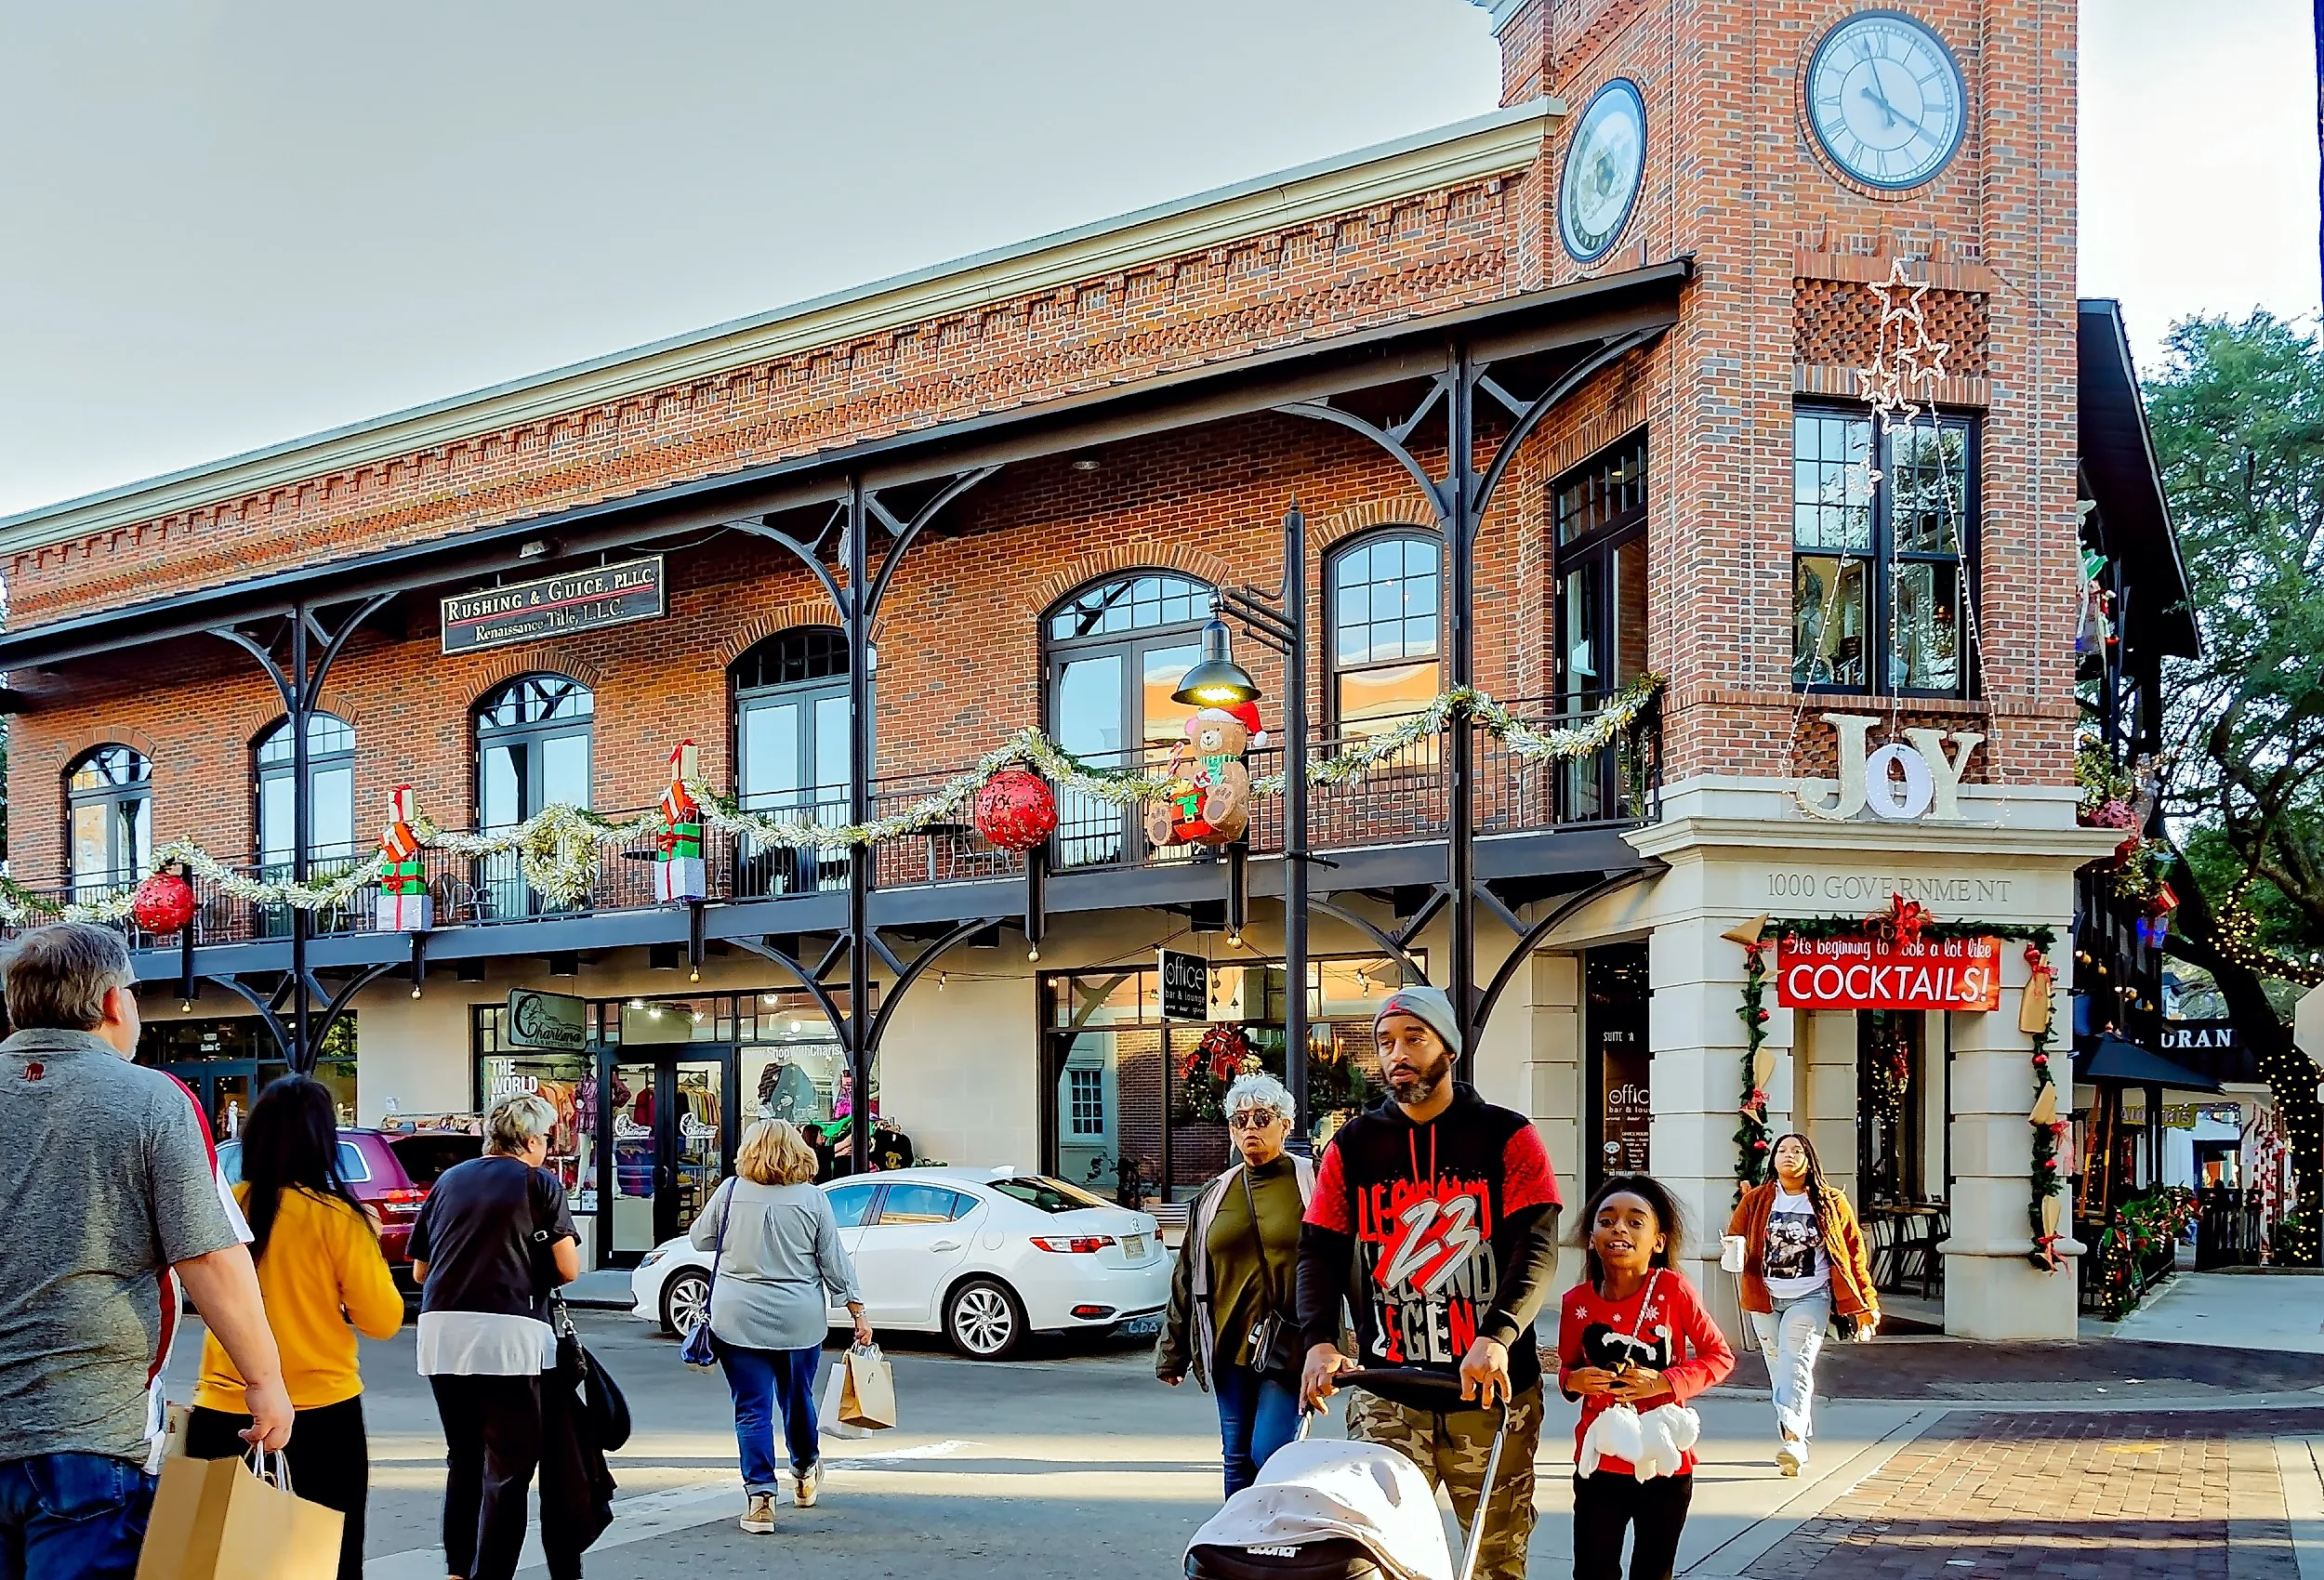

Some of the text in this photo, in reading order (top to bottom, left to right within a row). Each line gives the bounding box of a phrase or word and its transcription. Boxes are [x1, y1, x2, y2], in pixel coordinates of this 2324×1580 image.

[447, 594, 522, 622] RUSHING
[531, 590, 541, 605] &
[548, 577, 609, 601] GUICE,
[475, 621, 545, 642] Renaissance
[583, 598, 625, 621] L.L.C.
[1796, 713, 1986, 821] JOY
[1768, 873, 2013, 902] 1000 GOVERNMENT
[1816, 938, 1871, 961] beginning
[1876, 939, 1890, 956] to
[1900, 939, 1925, 957] ook
[1929, 942, 1939, 957] a
[1943, 938, 1963, 958] lot
[1967, 938, 1992, 959] like
[1165, 955, 1205, 991] office
[1788, 964, 1990, 1003] COCKTAILS!
[1165, 987, 1206, 1006] bar & lounge
[514, 994, 583, 1043] Charisma
[1603, 1031, 1623, 1042] SUITE
[490, 1059, 517, 1076] THE
[491, 1075, 538, 1094] WORLD
[1358, 1178, 1493, 1242] LED
[1381, 1193, 1481, 1297] 23
